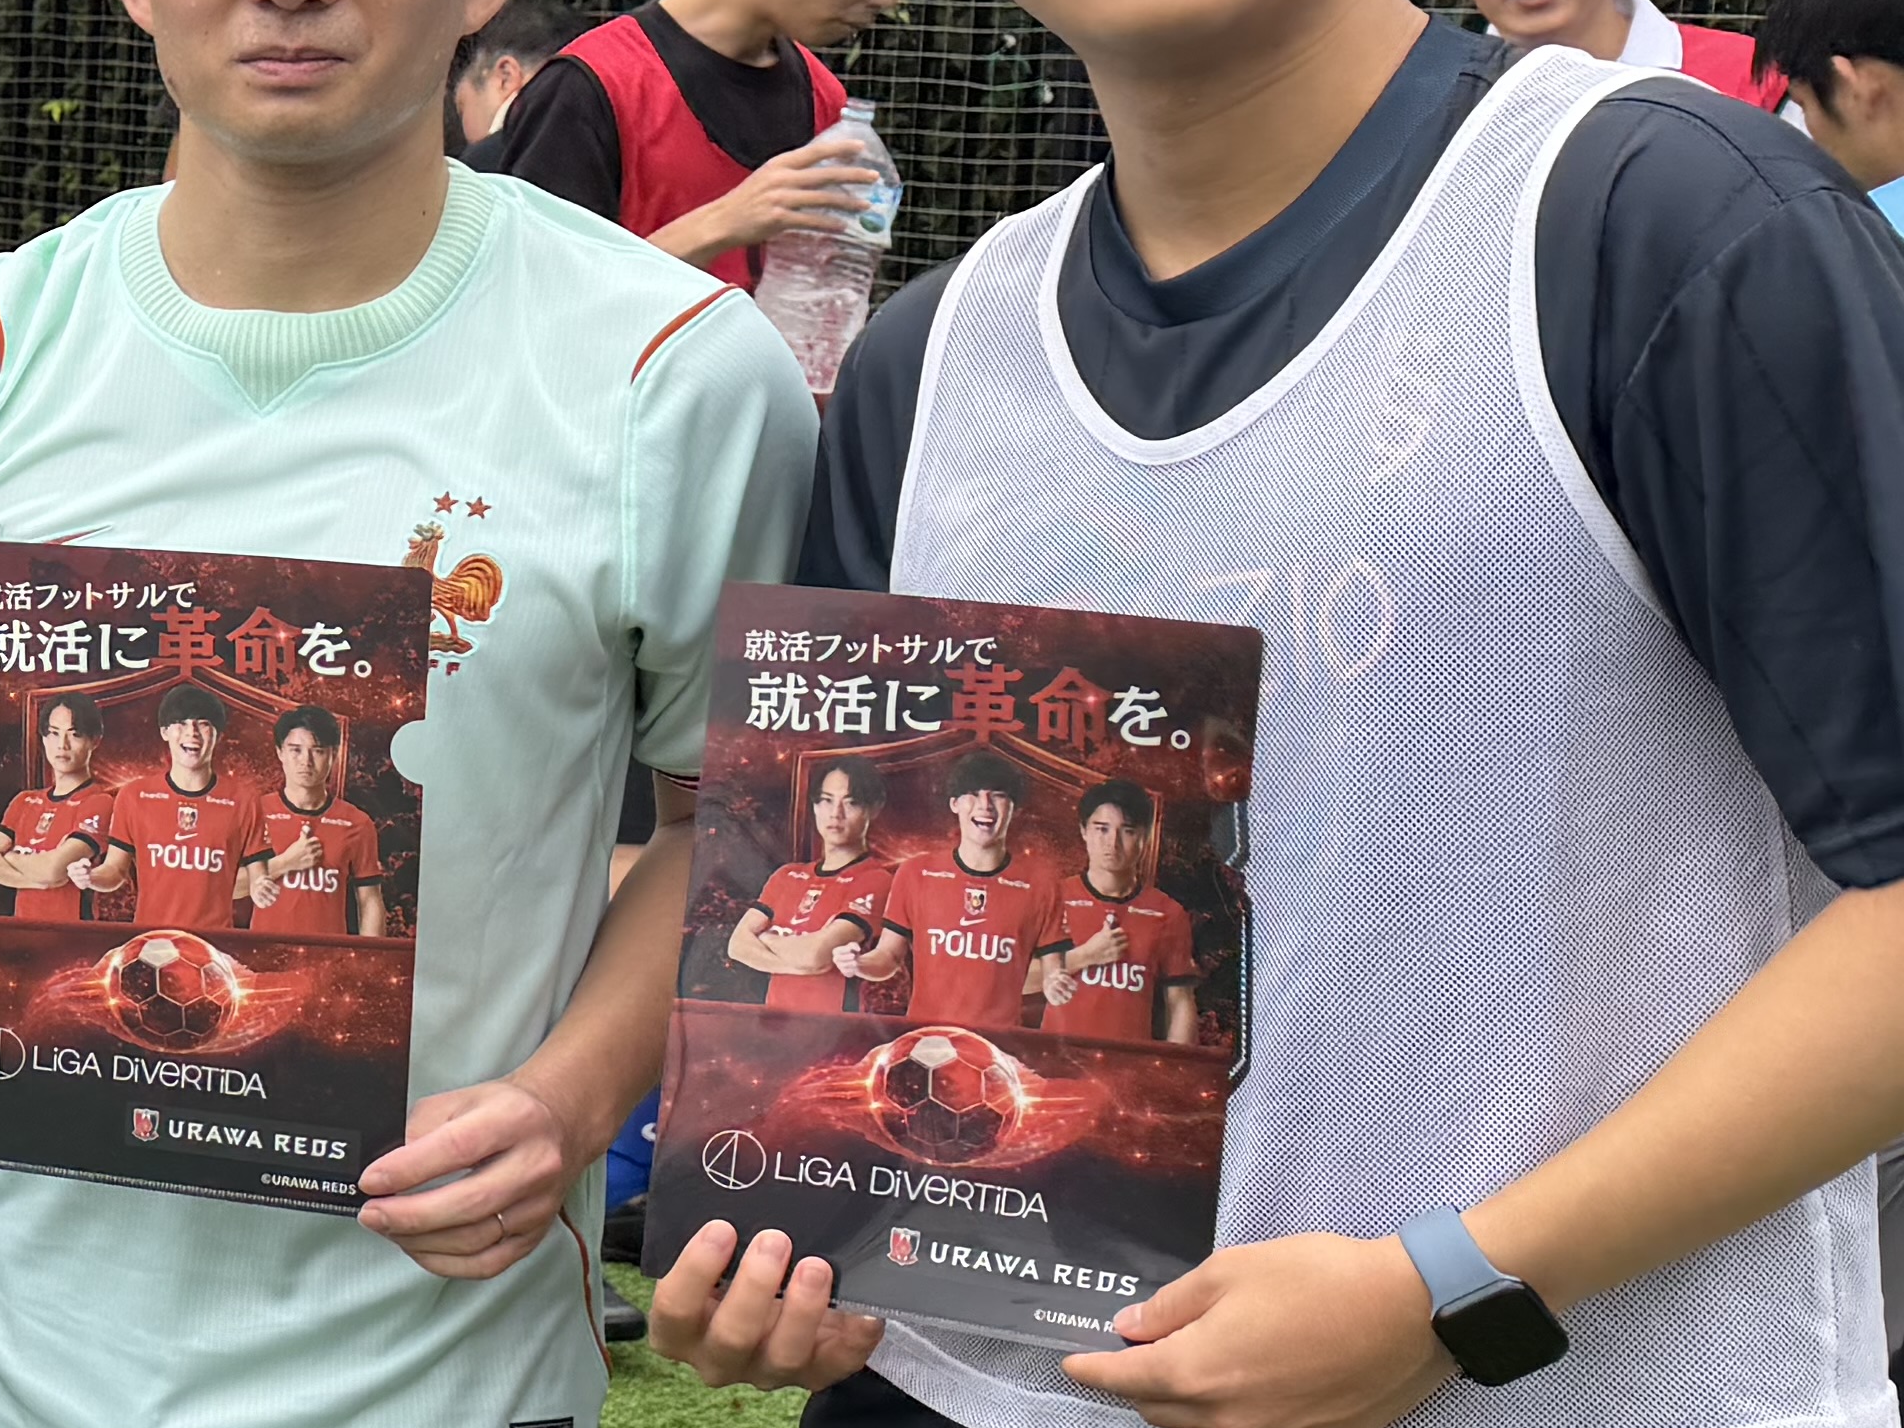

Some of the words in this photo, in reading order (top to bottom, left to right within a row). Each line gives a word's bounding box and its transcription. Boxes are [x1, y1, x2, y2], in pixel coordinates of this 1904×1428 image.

[744, 629, 996, 664] 就活フットサルで
[746, 662, 1190, 751] 就活に革命を。
[147, 844, 225, 872] POLUS
[284, 867, 339, 892] OLUS
[927, 929, 1015, 964] POLUS
[1081, 964, 1145, 992] OLUS
[169, 1121, 263, 1149] URAWA
[275, 1134, 347, 1159] REDS
[322, 1180, 356, 1194] REDS
[931, 1242, 1040, 1280] URAWA
[1054, 1263, 1140, 1296] REDS
